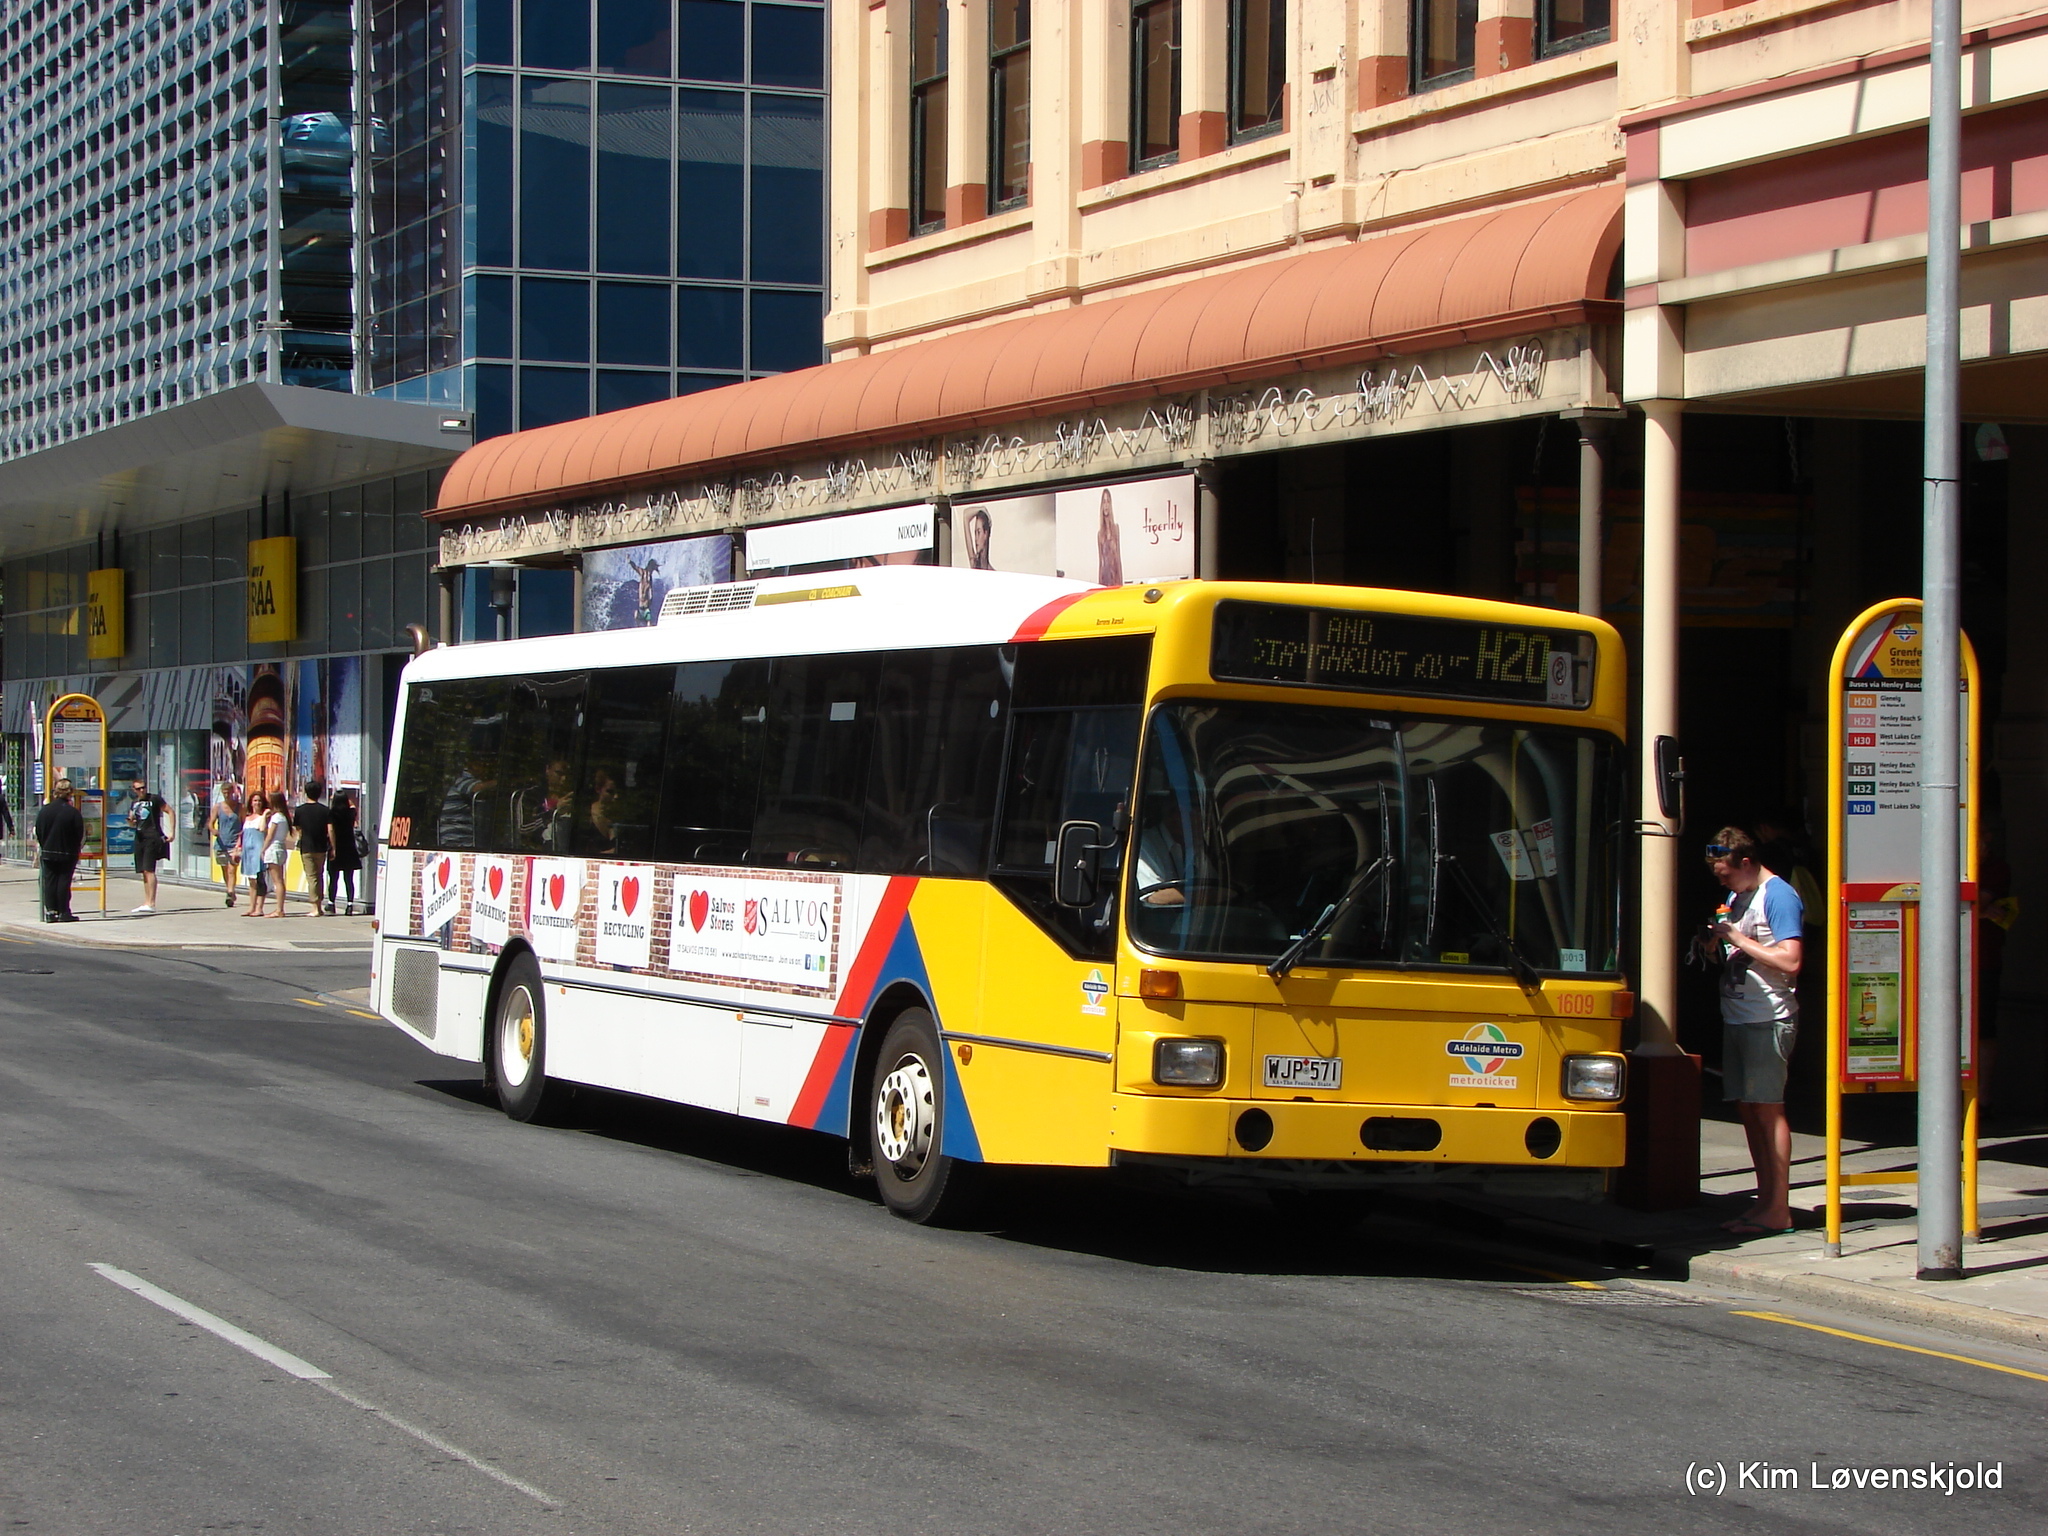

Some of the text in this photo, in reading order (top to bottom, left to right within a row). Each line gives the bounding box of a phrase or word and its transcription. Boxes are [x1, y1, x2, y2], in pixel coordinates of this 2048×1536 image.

[1142, 499, 1184, 545] tigerlily
[897, 523, 922, 540] NIXON
[1326, 616, 1374, 646] AND
[1475, 629, 1551, 684] H20
[1889, 647, 1922, 657] Grenfe
[1890, 657, 1920, 667] Street
[1881, 681, 1904, 690] Henley
[1905, 681, 1922, 689] Beac
[1854, 697, 1873, 707] H20
[85, 708, 97, 718] T1
[1880, 715, 1898, 723] Henley
[1854, 717, 1872, 727] H22
[1853, 736, 1871, 746] H30
[1853, 765, 1873, 775] H31
[1853, 784, 1872, 794] H32
[1852, 804, 1872, 814] N30
[389, 816, 411, 847] 1609
[431, 871, 437, 896] I
[481, 866, 487, 893] I
[540, 877, 547, 906] I
[612, 879, 619, 911] I
[427, 884, 458, 919] SHOPPING
[711, 897, 735, 914] Salvos
[475, 901, 507, 924] DONATING
[678, 894, 687, 928] I
[532, 914, 574, 929] VOLUNTEERING
[710, 914, 734, 932] Stores
[758, 897, 829, 943] SALVOS
[603, 921, 645, 939] RECYCLING
[1556, 993, 1595, 1015] 1609
[1453, 1043, 1518, 1055] Adelaide Metro
[1268, 1058, 1337, 1082] WJP 571
[1450, 1076, 1515, 1087] metroticket
